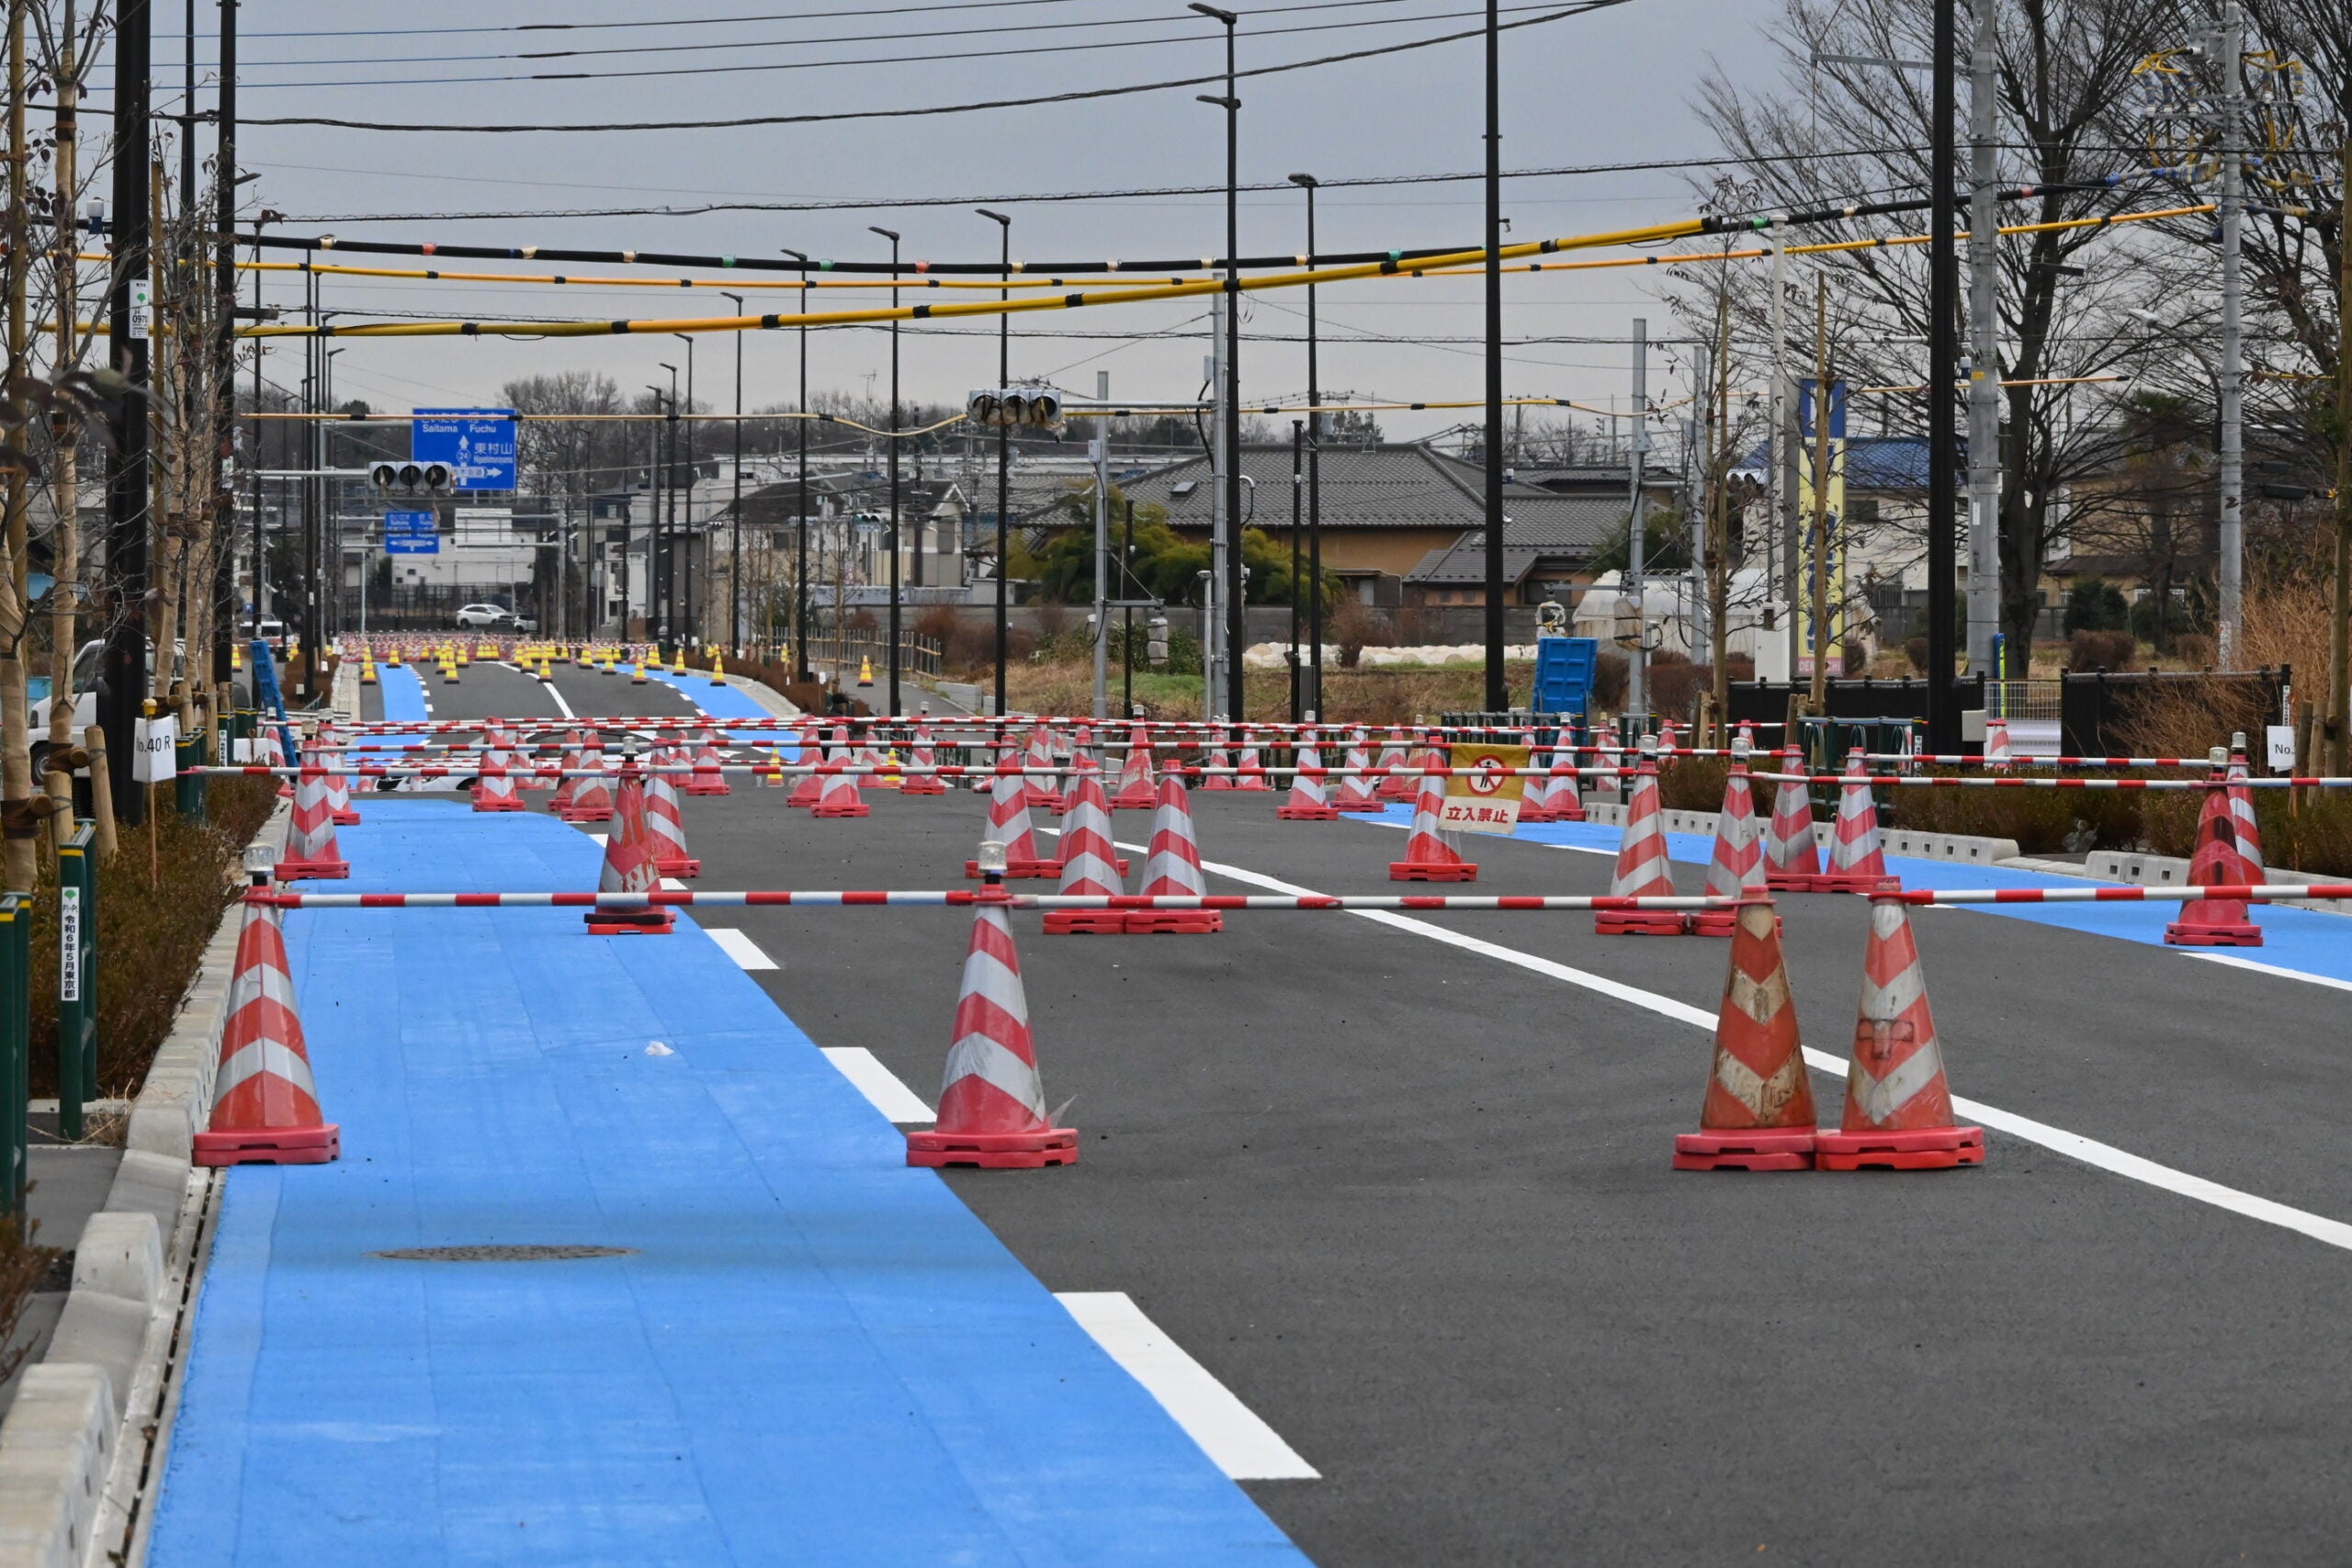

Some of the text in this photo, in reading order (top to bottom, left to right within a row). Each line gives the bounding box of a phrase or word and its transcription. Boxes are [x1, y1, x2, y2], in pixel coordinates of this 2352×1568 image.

[423, 424, 497, 433] Saitama Fuchu
[474, 443, 513, 455] 東村山
[458, 452, 469, 460] 24
[164, 735, 171, 750] R
[1445, 806, 1509, 824] 立入禁止
[64, 915, 75, 998] 令和6年5月東京都
